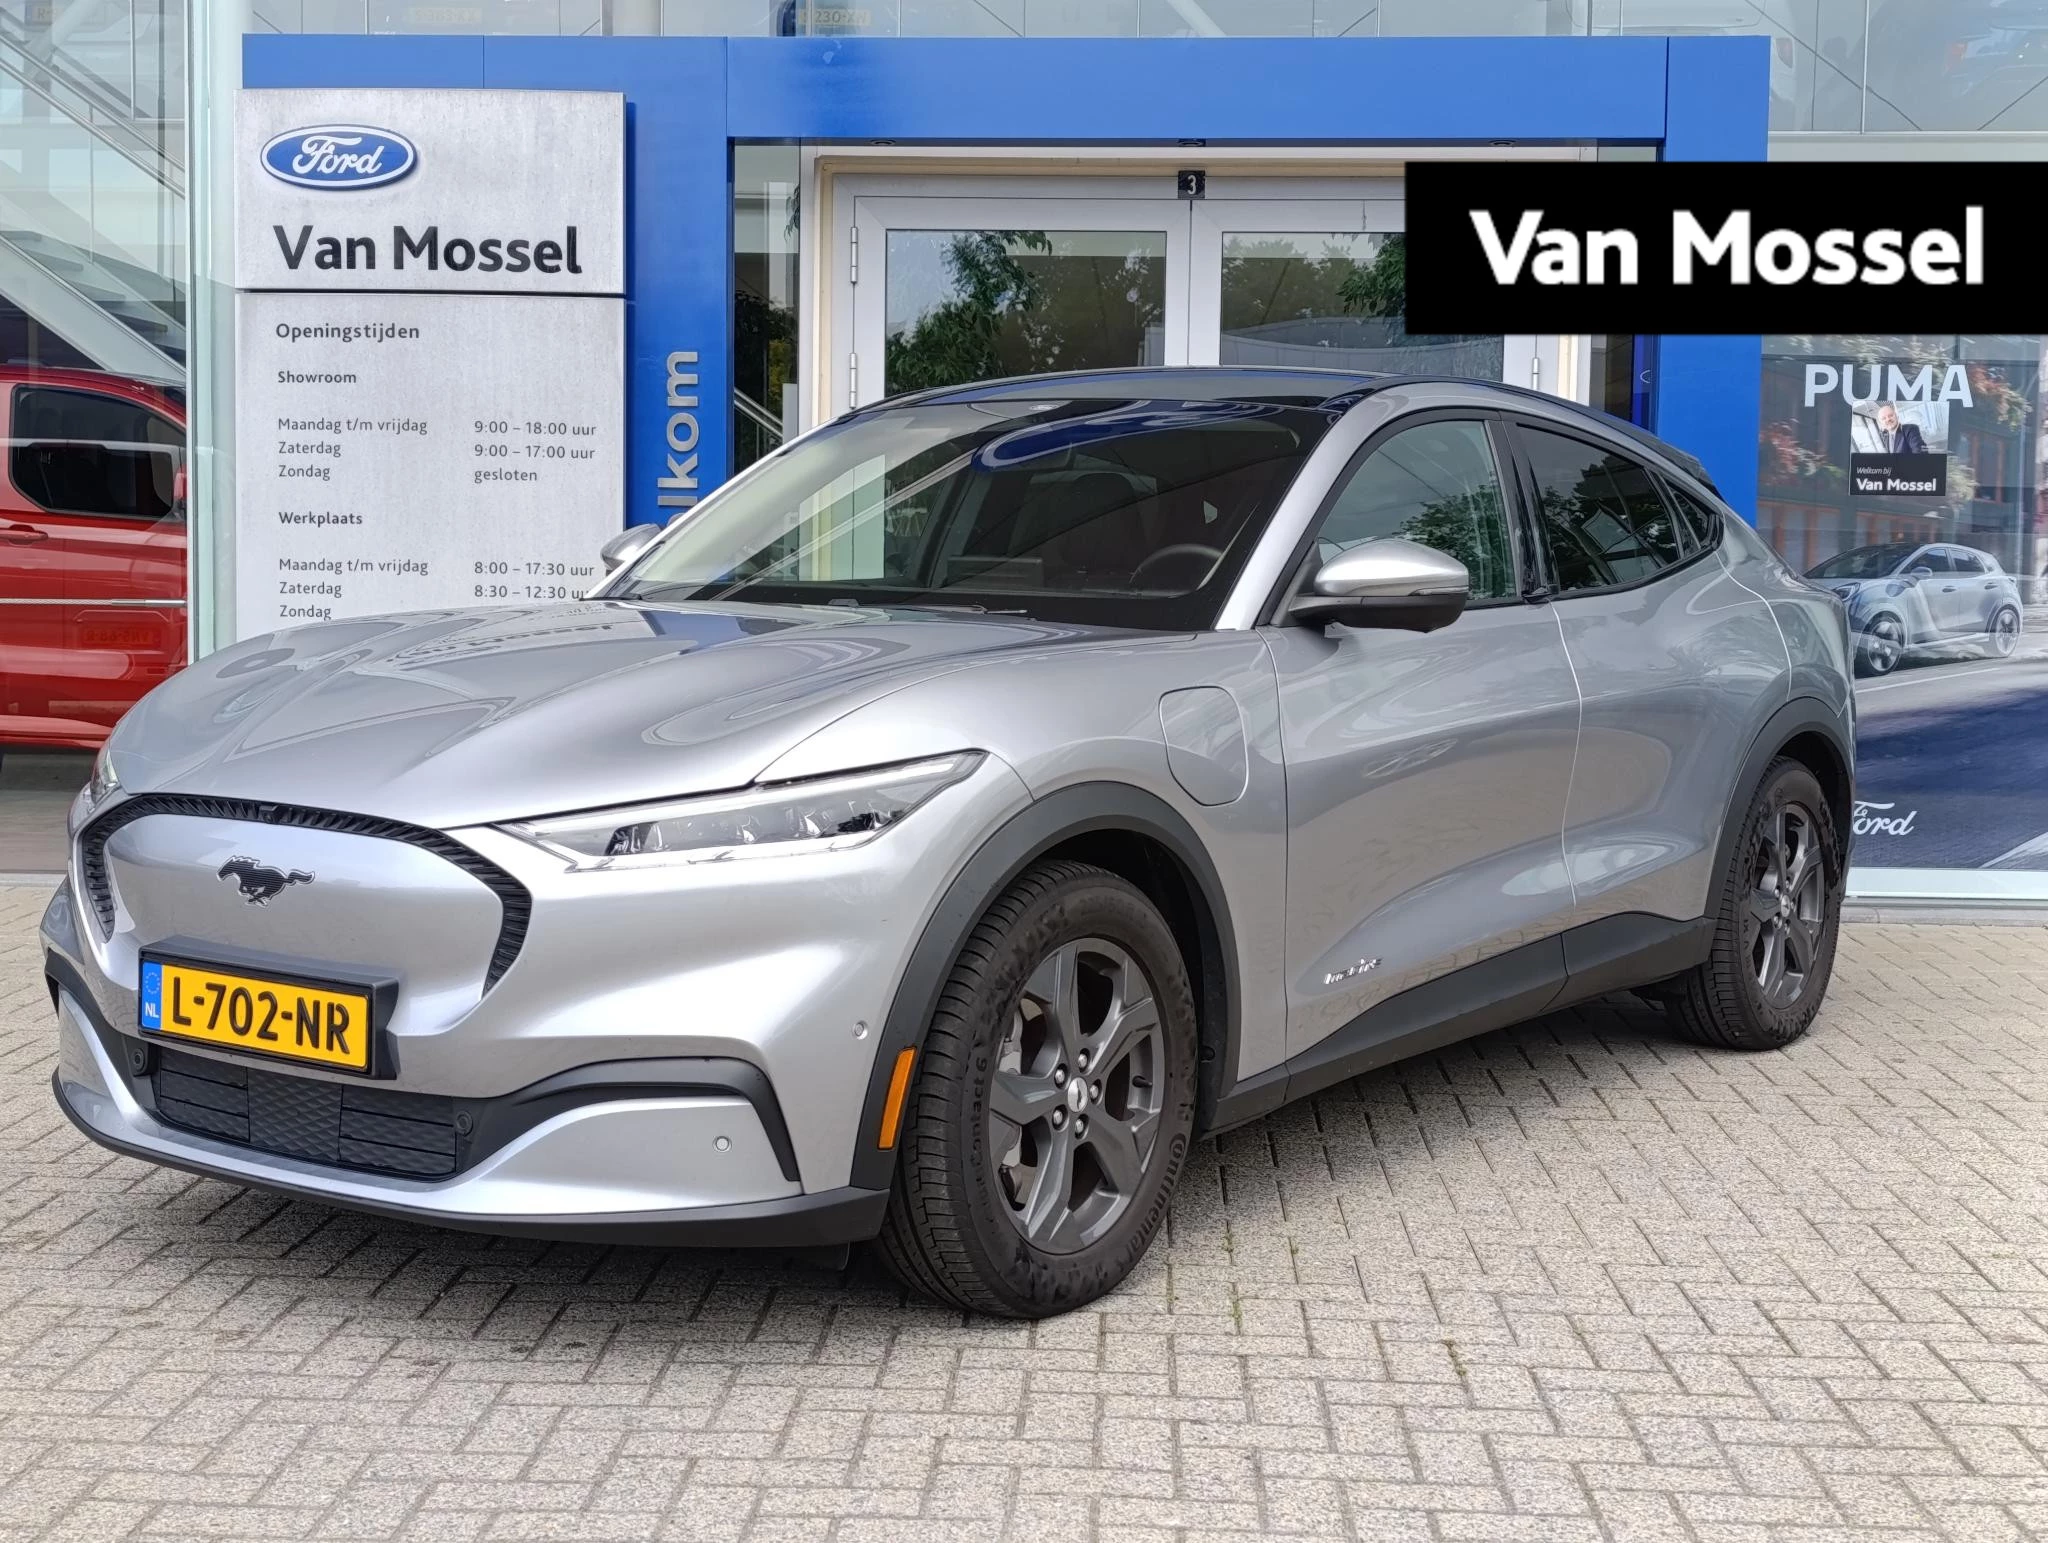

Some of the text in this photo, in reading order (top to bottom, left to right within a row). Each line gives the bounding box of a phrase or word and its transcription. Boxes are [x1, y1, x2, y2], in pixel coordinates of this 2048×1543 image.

[292, 135, 385, 175] Ford
[1187, 174, 1197, 195] 3
[273, 225, 583, 274] Van Mossel
[276, 323, 420, 342] Openingstijden
[278, 370, 357, 384] Showroom
[1804, 363, 1973, 408] PUMA
[278, 418, 428, 435] Maandag t/m vrijdag
[474, 420, 508, 434] 9:00
[526, 421, 567, 435] 18:00
[572, 426, 597, 436] uur
[657, 351, 700, 524] lkom
[278, 441, 342, 458] Zaterdag
[474, 443, 508, 457] 9:00
[526, 445, 565, 459] 17:00
[570, 449, 596, 460] uur
[278, 464, 331, 481] Zondag
[474, 467, 538, 484] gesloten
[1856, 466, 1892, 476] Welkom bij
[1856, 478, 1937, 491] Van Mossel
[279, 511, 363, 527] Werkplaats
[279, 558, 429, 576] Maandag t/m vrijdag
[474, 561, 508, 575] 8:00
[526, 562, 565, 576] 17:30
[570, 566, 595, 577] uur
[279, 581, 342, 598] Zaterdag
[474, 584, 508, 598] 8:30
[526, 585, 566, 599] 12:30
[279, 604, 332, 621] Zondag
[145, 1002, 159, 1019] NL
[172, 976, 350, 1055] L-702-NR
